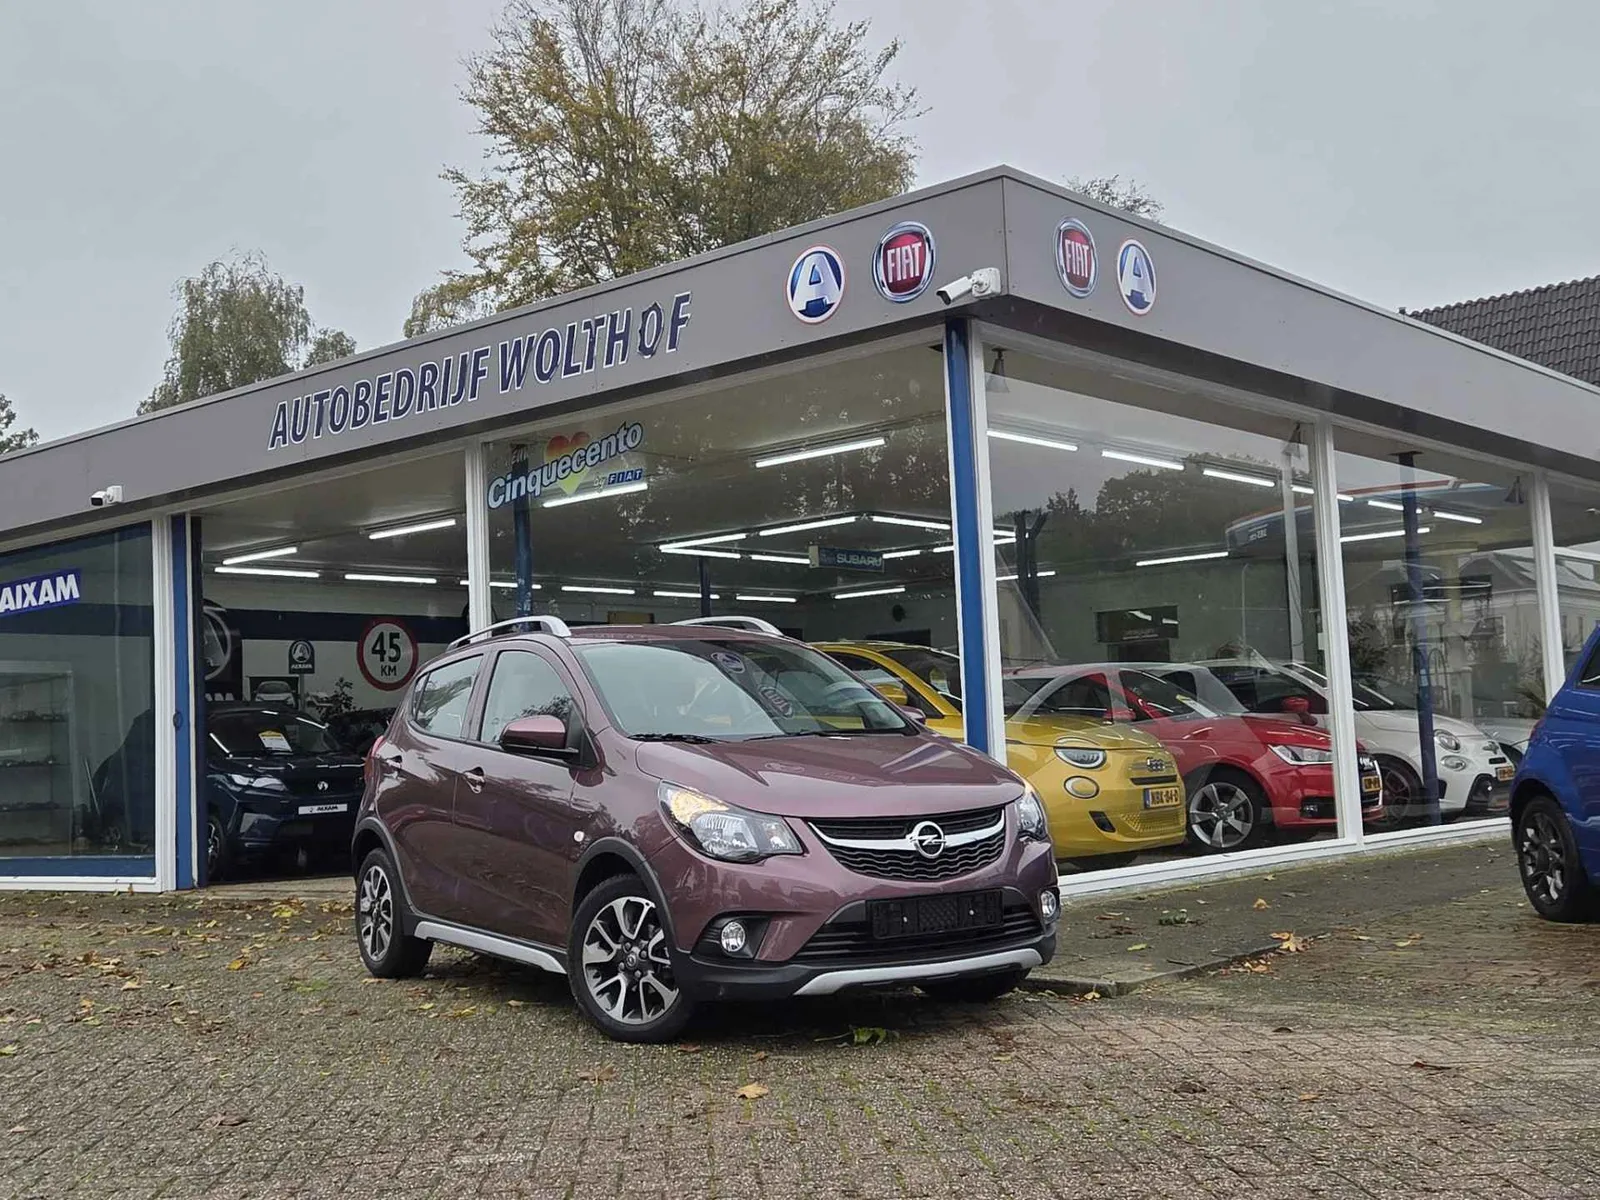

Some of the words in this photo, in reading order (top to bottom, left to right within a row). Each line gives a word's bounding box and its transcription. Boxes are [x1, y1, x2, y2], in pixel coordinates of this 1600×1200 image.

[886, 242, 923, 284] FIAT
[1064, 238, 1090, 279] FIAT
[267, 346, 491, 451] AUTOBEDRIJF
[487, 421, 644, 510] Cinquecento
[608, 469, 643, 485] FIAT
[836, 553, 882, 567] SUBARU
[0, 573, 80, 613] AIXAM
[371, 631, 401, 663] 45
[380, 665, 397, 677] KM
